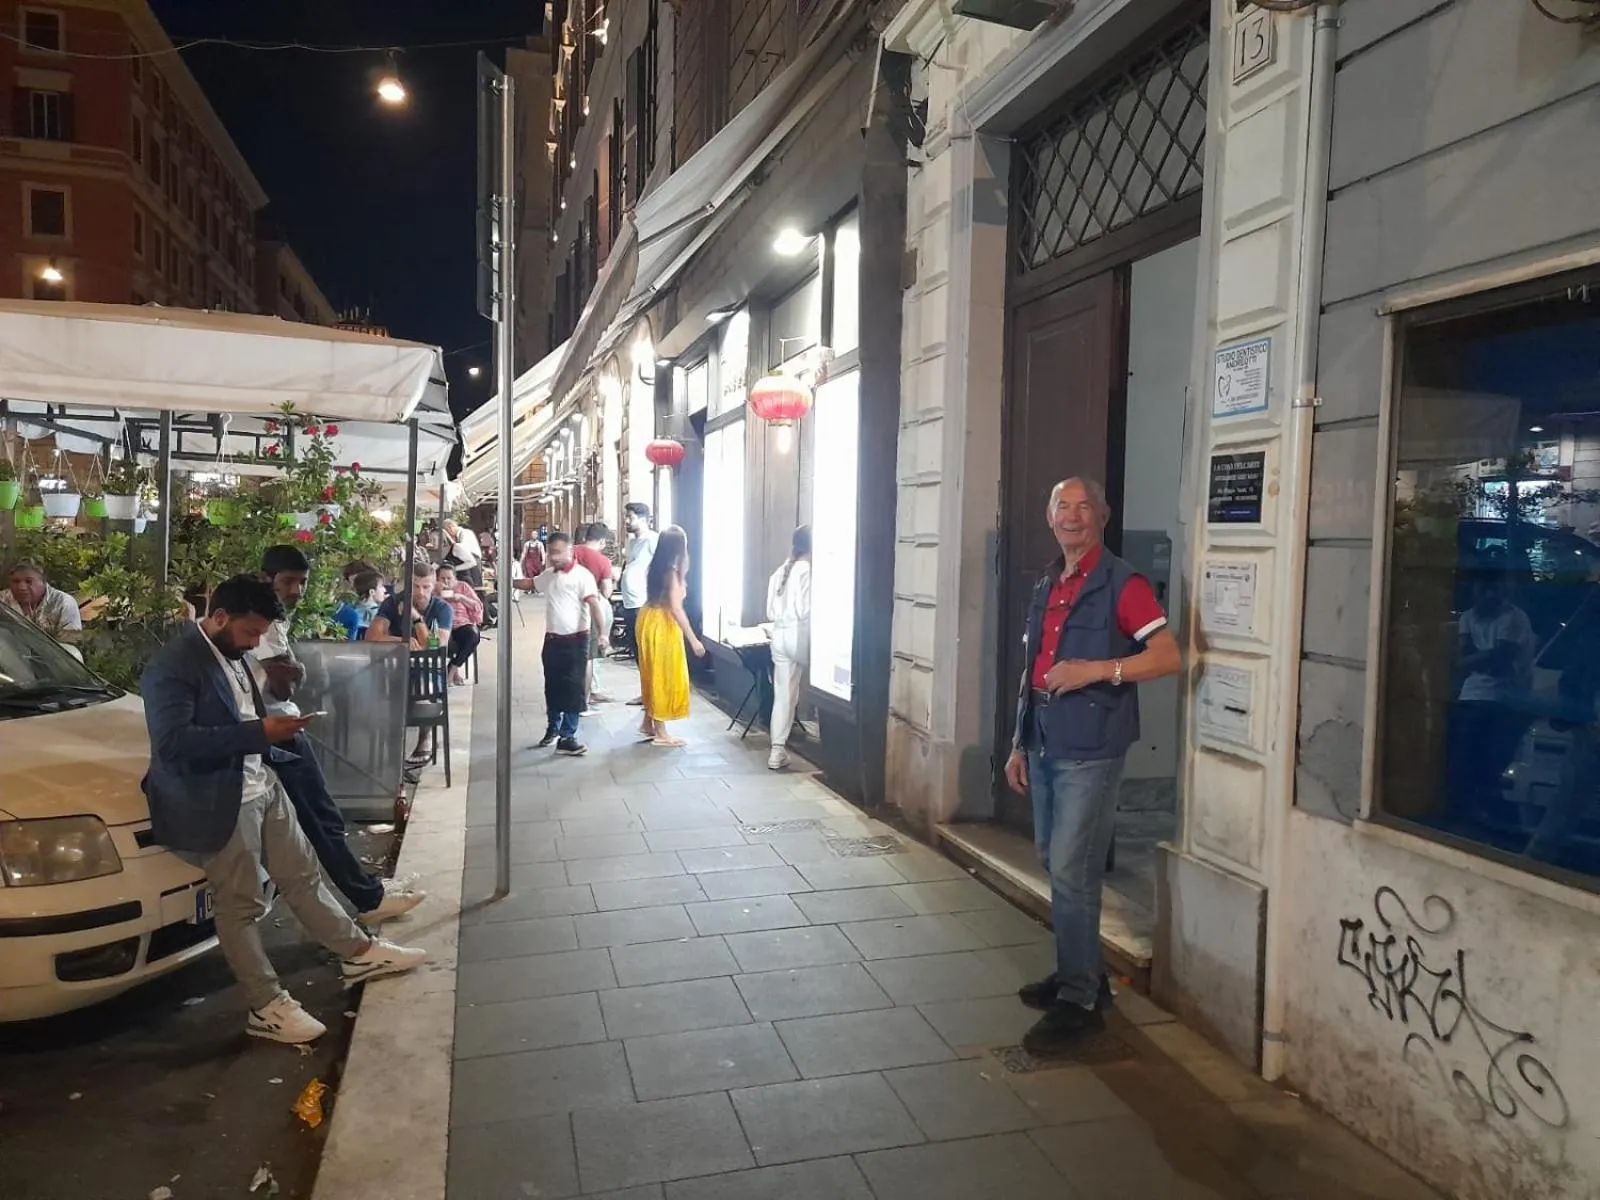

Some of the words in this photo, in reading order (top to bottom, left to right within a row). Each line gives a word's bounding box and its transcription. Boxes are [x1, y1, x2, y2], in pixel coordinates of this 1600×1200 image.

[1240, 16, 1264, 68] 13
[1216, 351, 1236, 364] STUDIO
[1236, 342, 1268, 360] DENTISTICO
